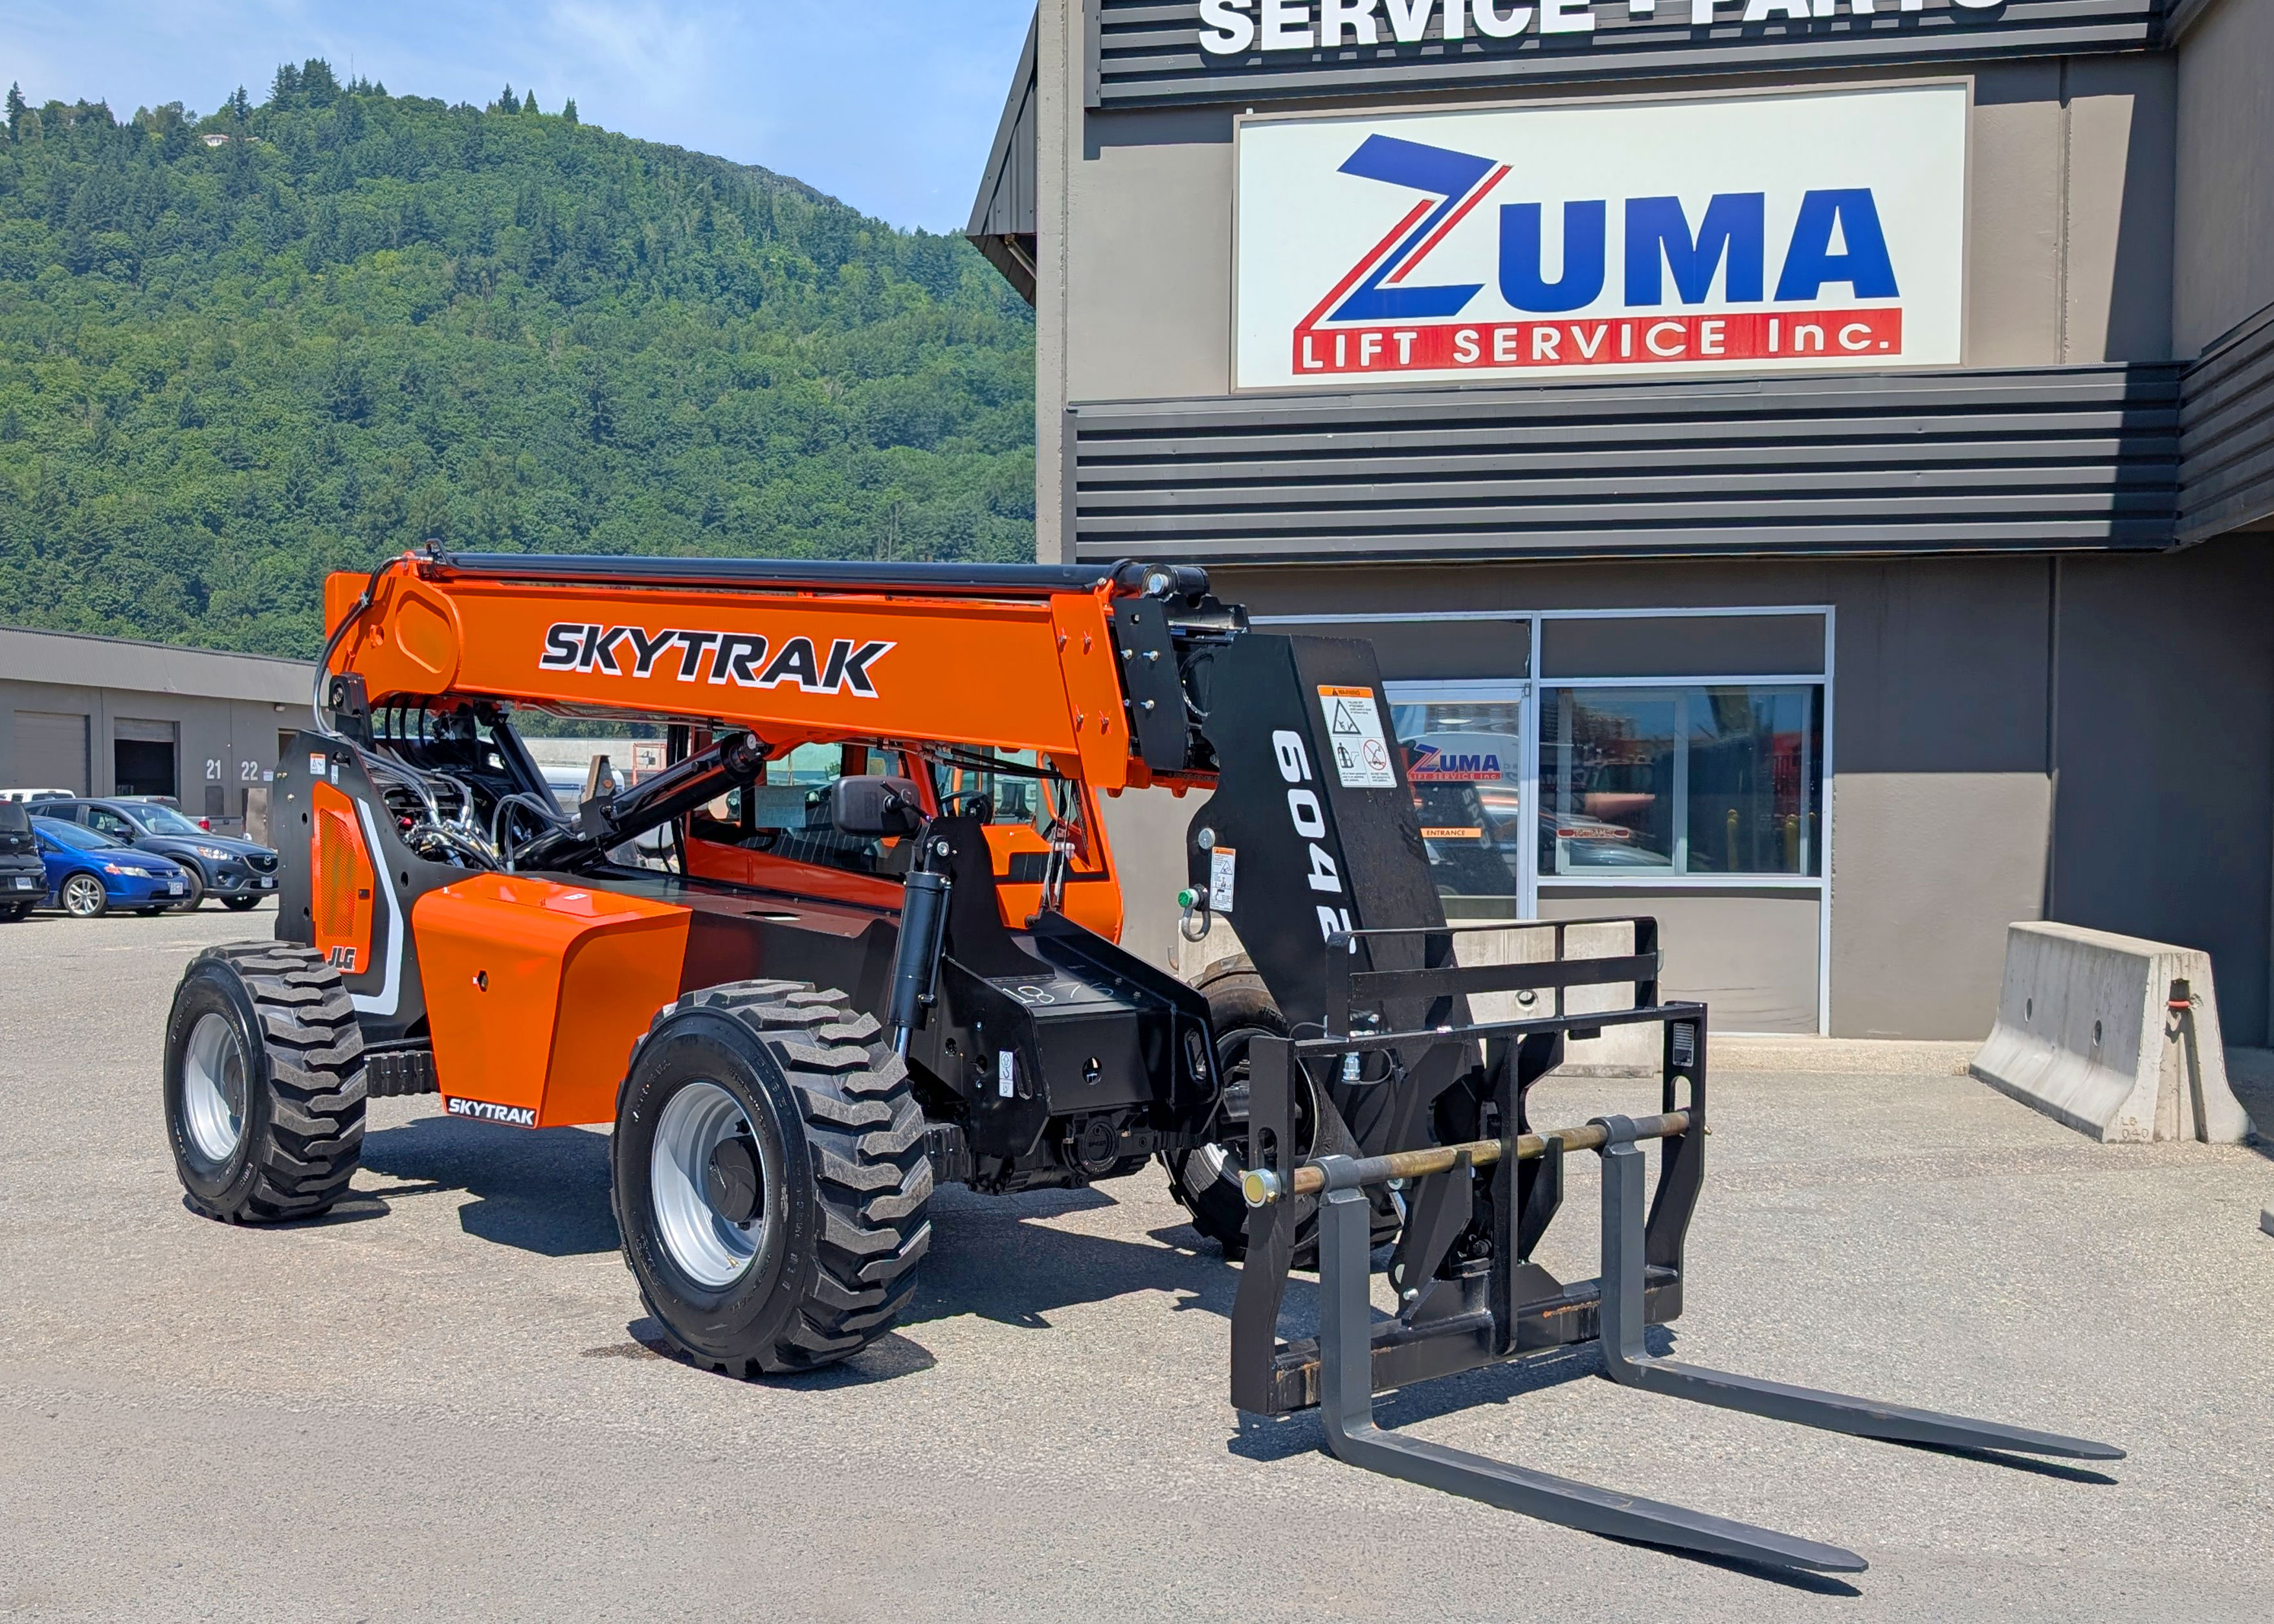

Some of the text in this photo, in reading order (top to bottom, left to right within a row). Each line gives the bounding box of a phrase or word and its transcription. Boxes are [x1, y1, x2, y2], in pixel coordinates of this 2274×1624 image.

[1326, 133, 1900, 321] ZUMA
[1302, 318, 1889, 369] LIFT SERVICE Inc.
[539, 622, 897, 698] SKYTRAK
[206, 759, 221, 780] 21
[241, 761, 258, 781] 22
[1412, 744, 1500, 773] ZUMA
[1272, 729, 1357, 955] 6042
[328, 946, 357, 971] JLG
[448, 1098, 536, 1126] SKYTRAK
